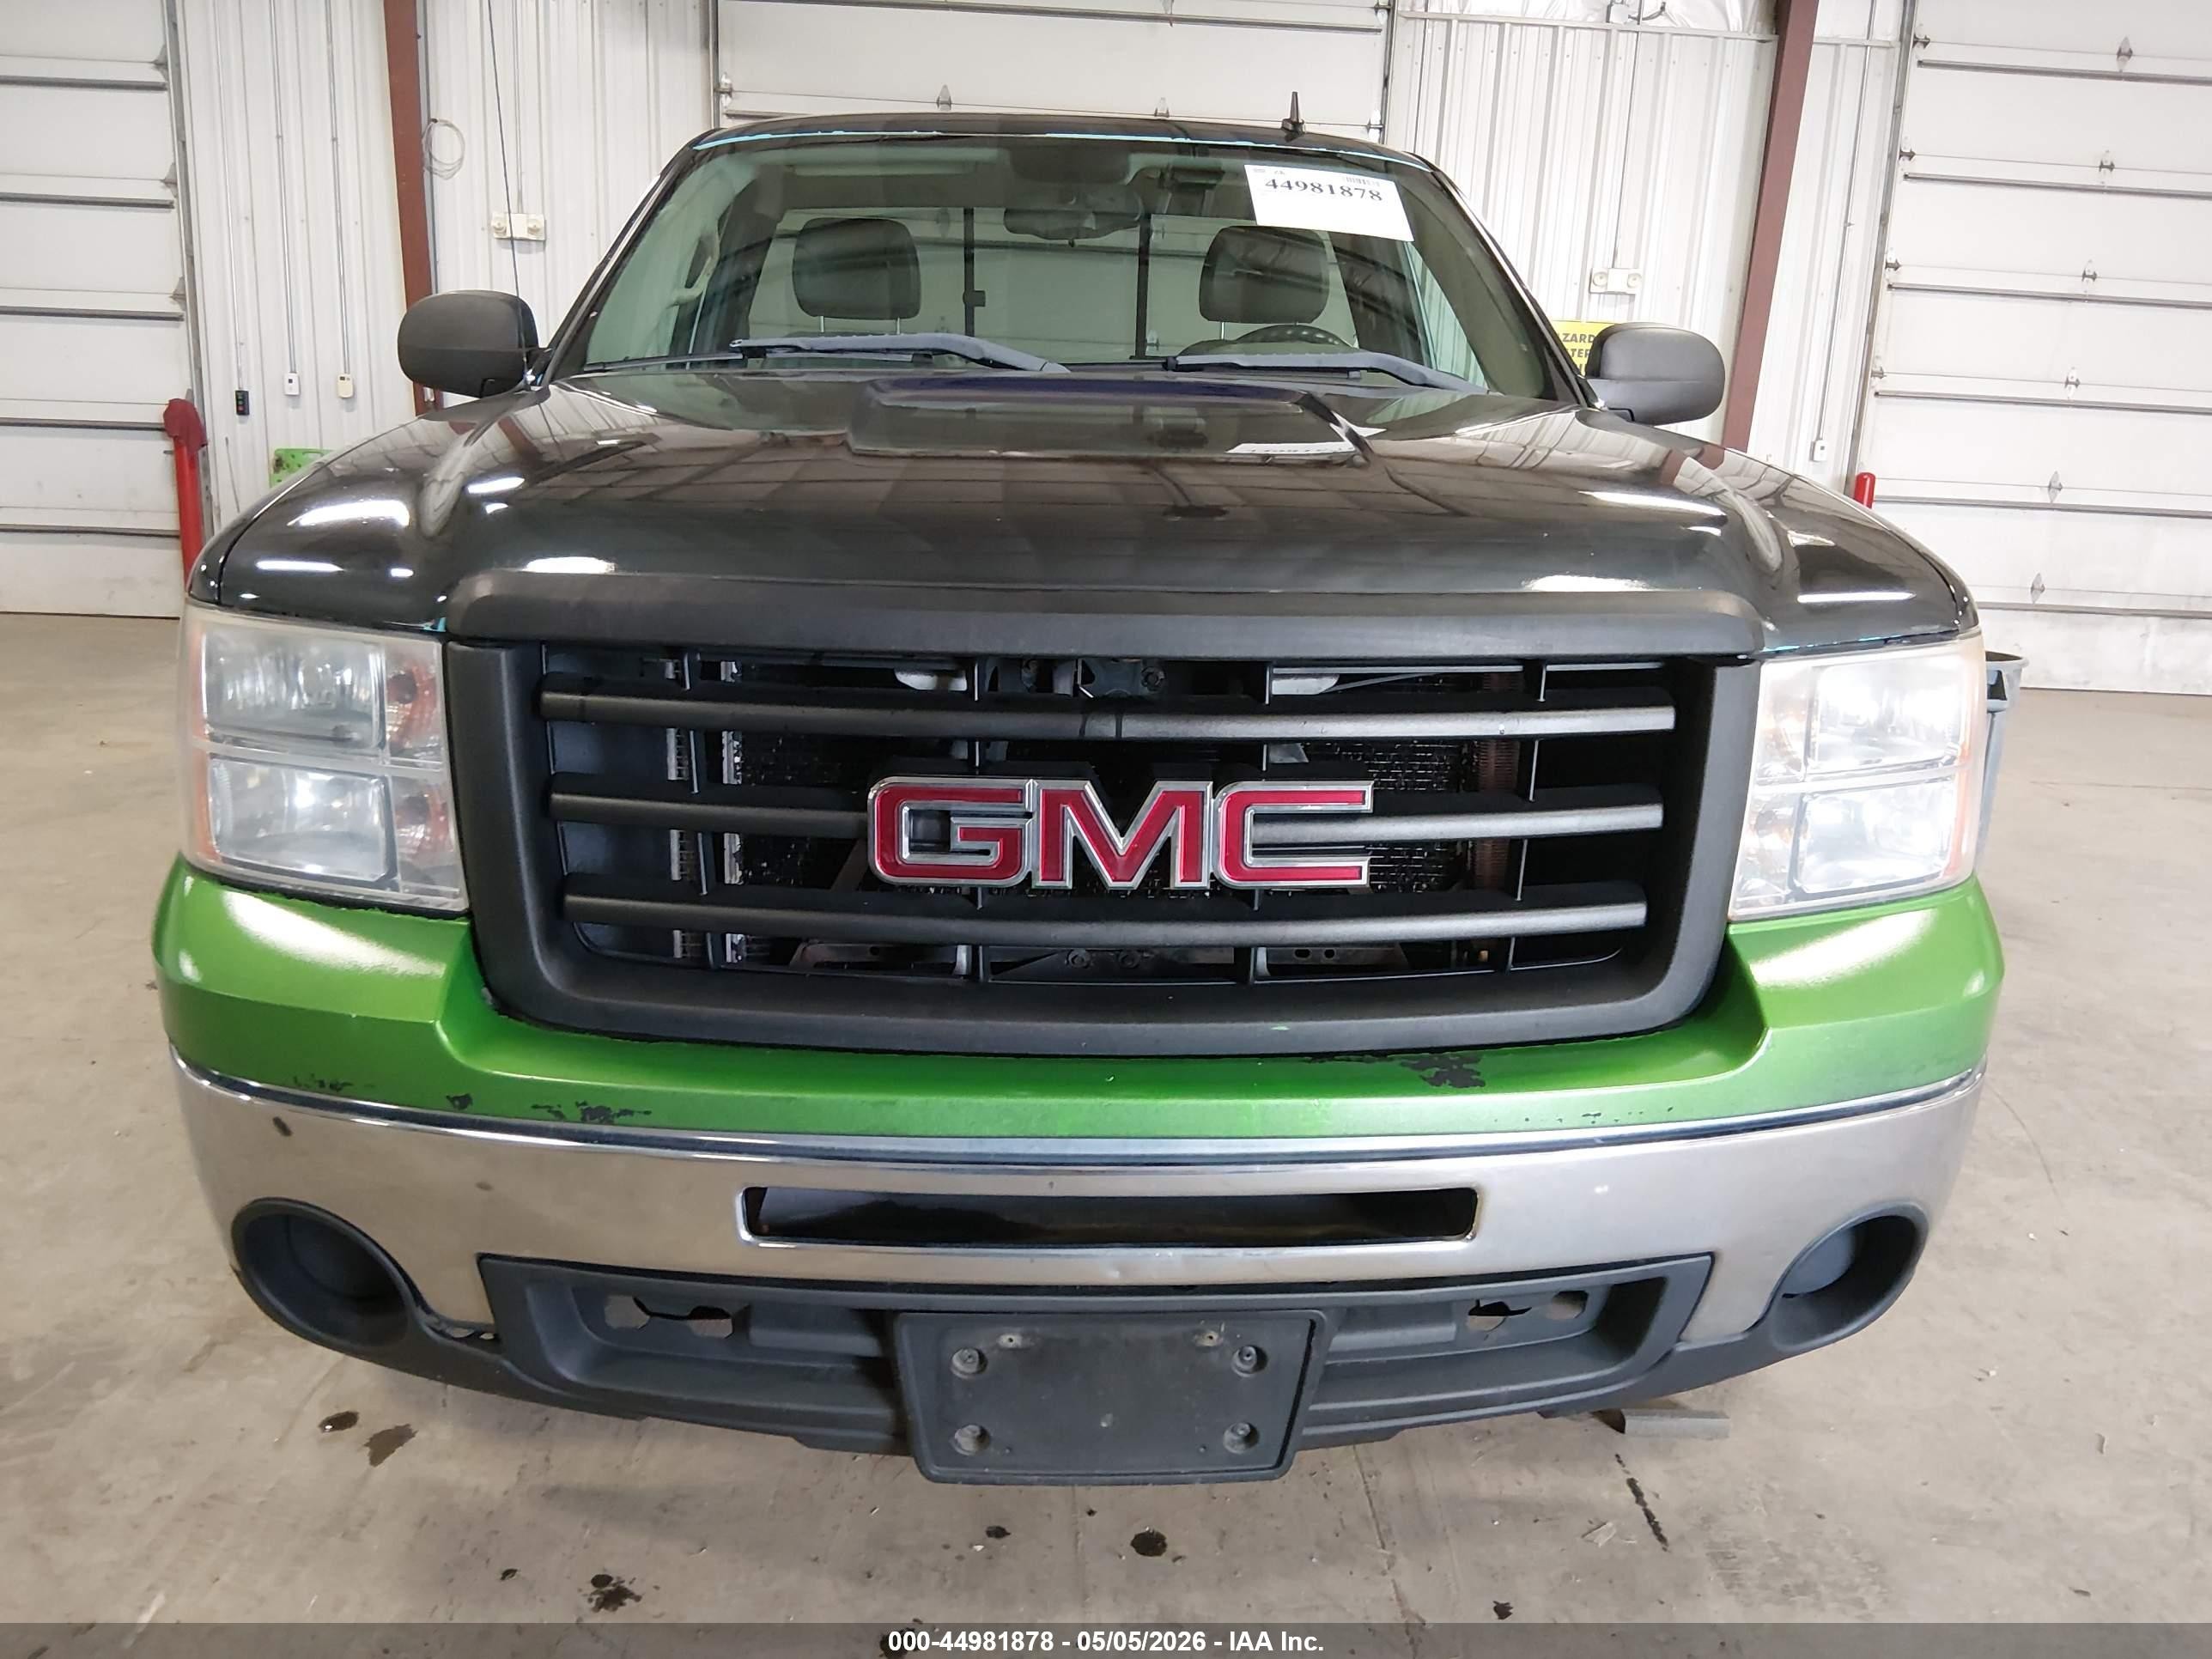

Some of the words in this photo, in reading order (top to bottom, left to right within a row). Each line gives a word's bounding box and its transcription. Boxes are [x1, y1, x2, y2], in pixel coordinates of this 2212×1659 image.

[1265, 179, 1382, 202] 44981878
[1558, 333, 1595, 343] ZARD
[867, 775, 1374, 890] GMC
